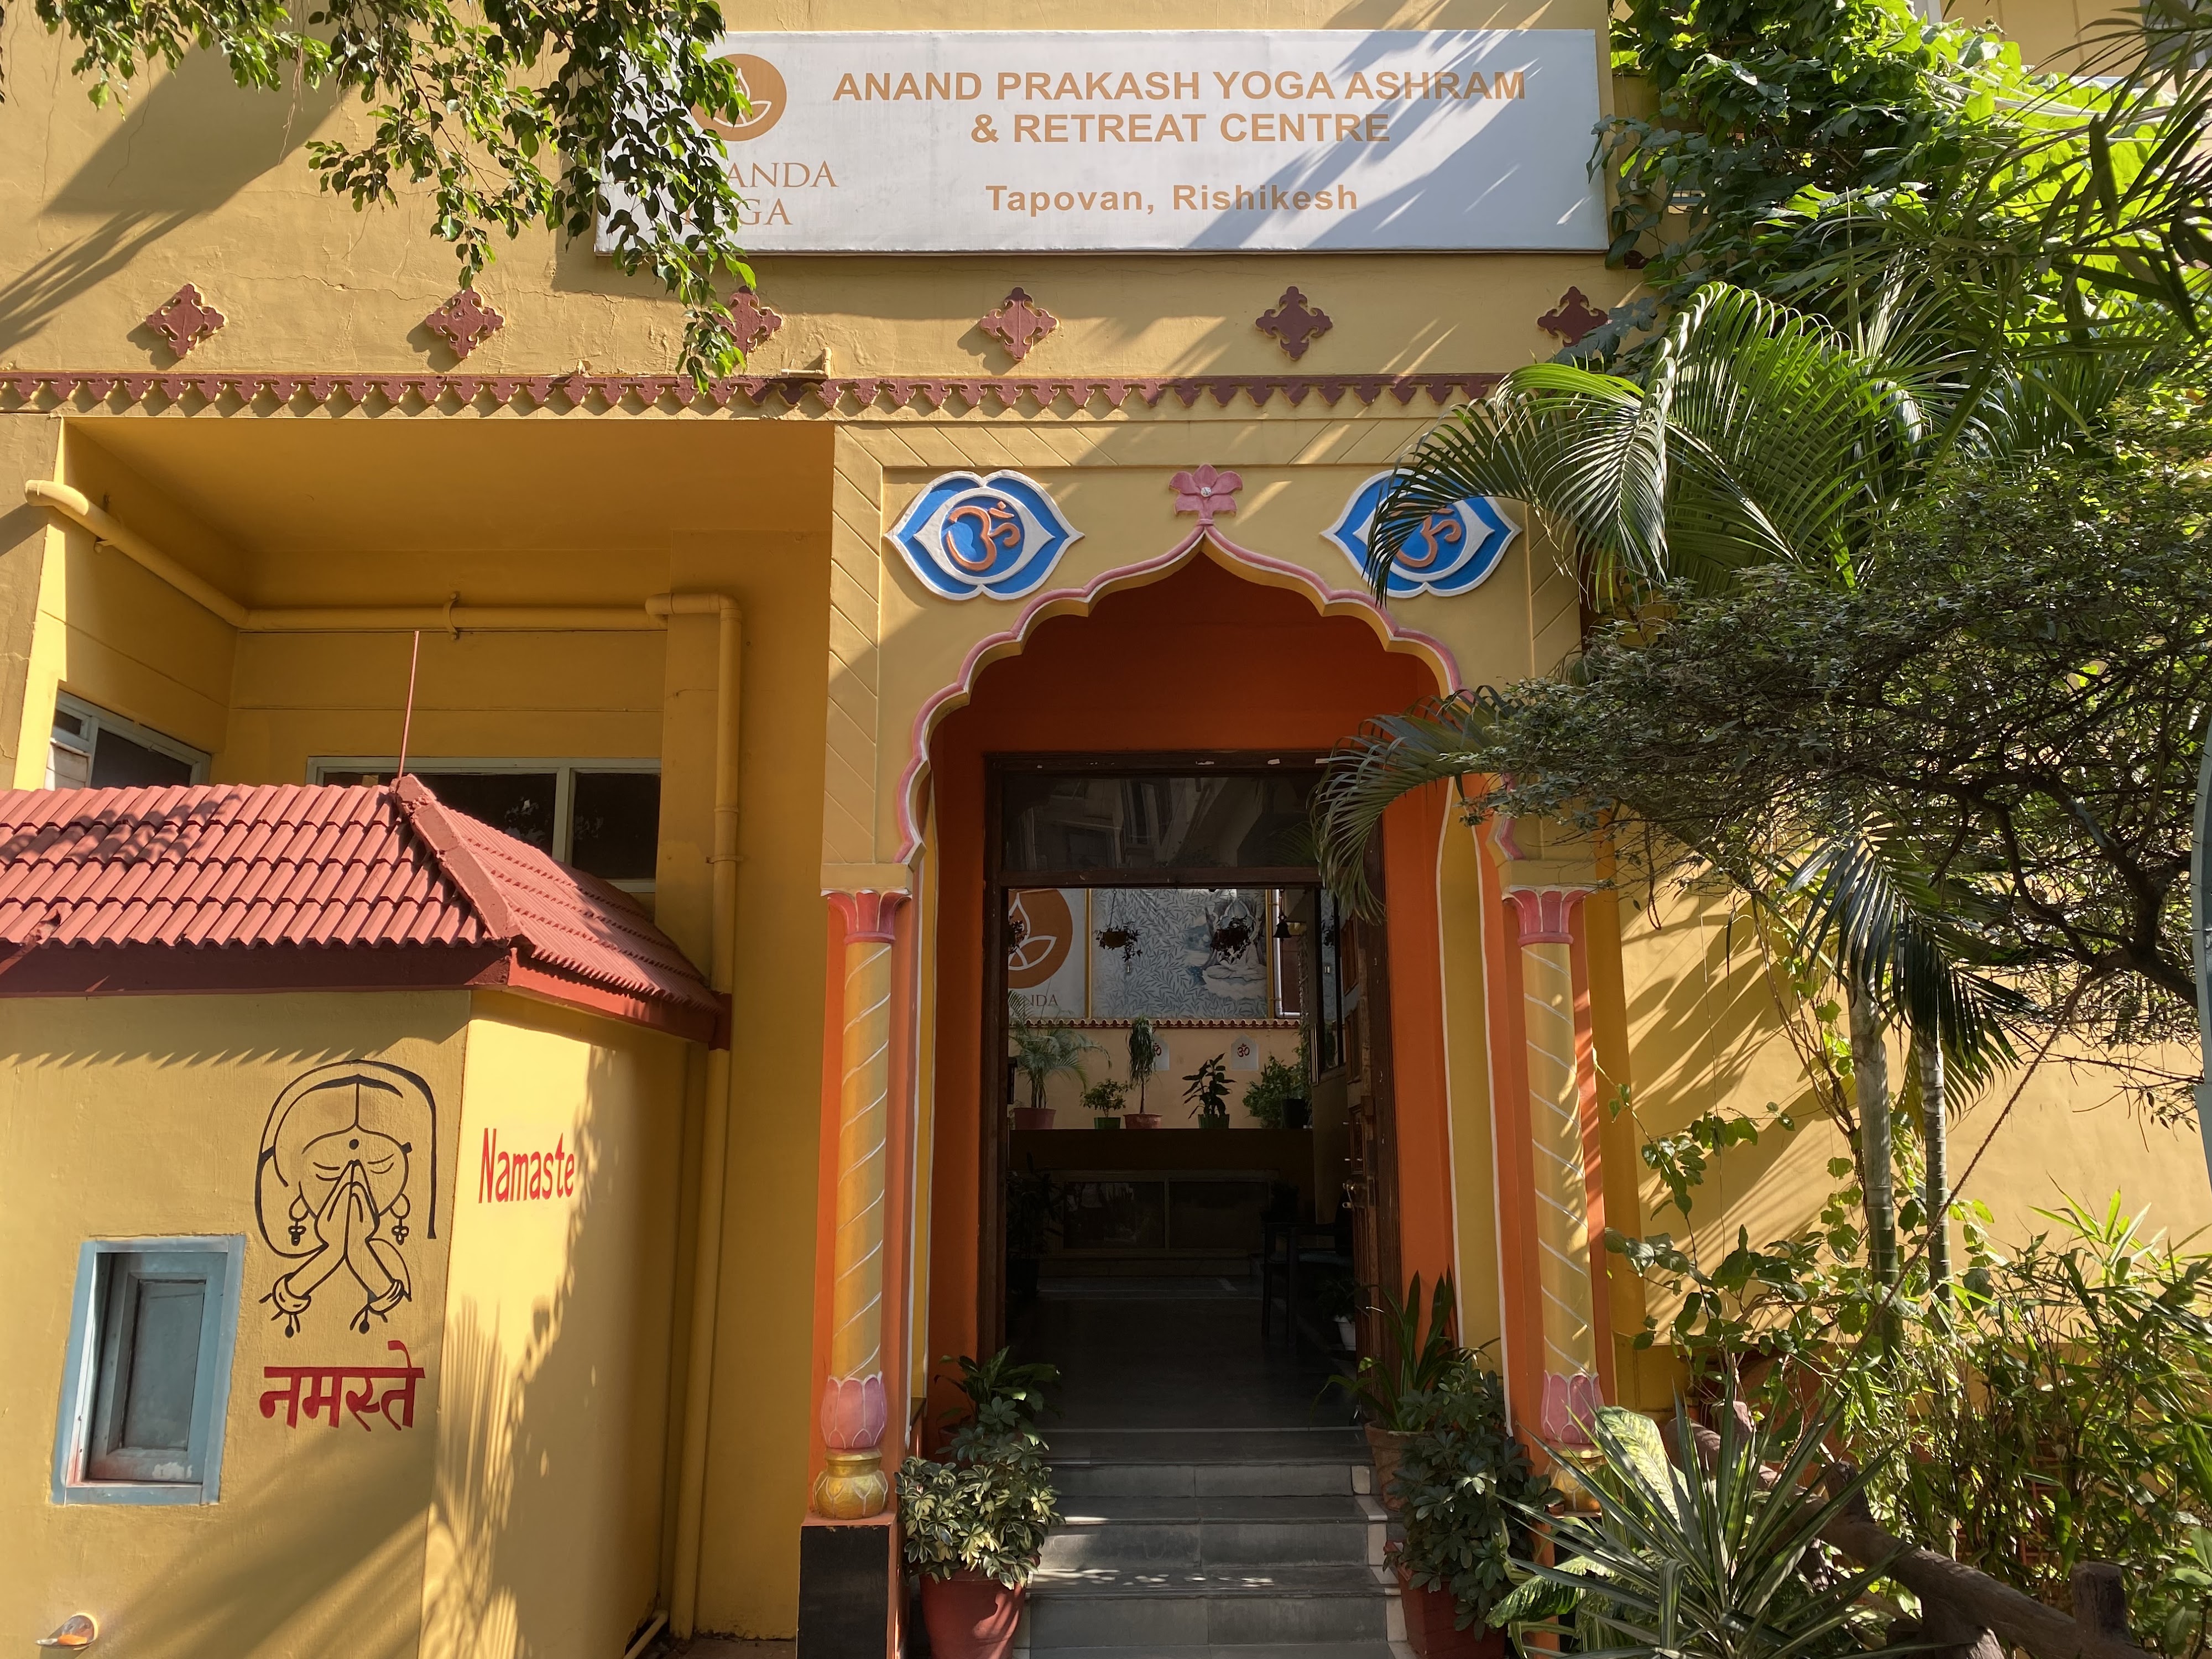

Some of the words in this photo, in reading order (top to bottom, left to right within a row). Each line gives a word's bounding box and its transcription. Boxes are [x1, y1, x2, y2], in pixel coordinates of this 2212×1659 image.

[832, 72, 982, 101] ANAND
[997, 71, 1199, 101] PRAKASH
[1214, 71, 1335, 100] YOGA
[1345, 71, 1524, 100] ASHRAM
[971, 114, 999, 144] &
[1014, 113, 1207, 143] RETREAT
[1220, 113, 1387, 142] CENTRE
[985, 185, 1154, 217] Tapovan,
[1173, 184, 1357, 210] Rishikesh
[478, 1128, 575, 1203] Namaste
[259, 1340, 425, 1431] नमस्ते
